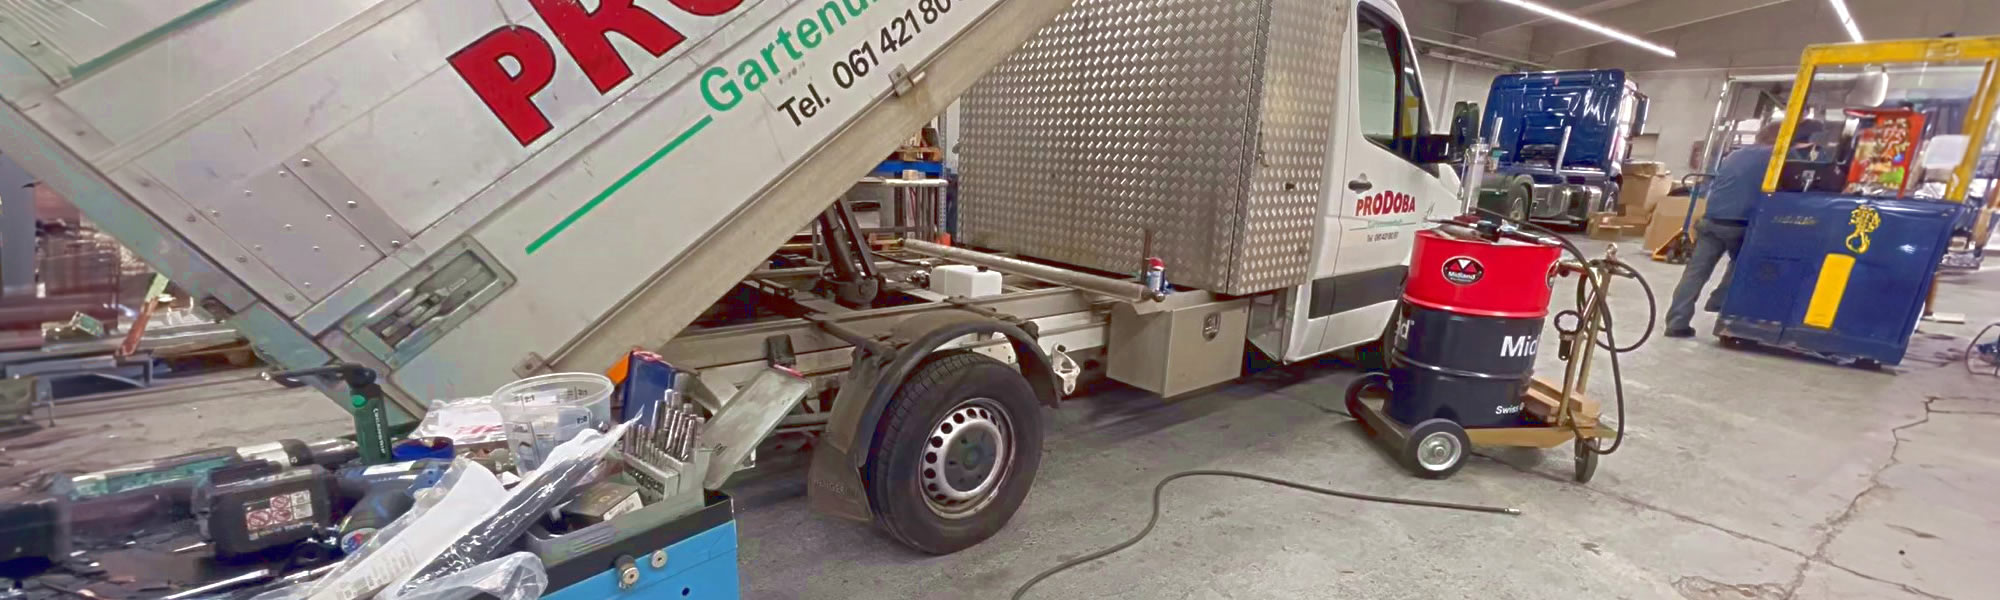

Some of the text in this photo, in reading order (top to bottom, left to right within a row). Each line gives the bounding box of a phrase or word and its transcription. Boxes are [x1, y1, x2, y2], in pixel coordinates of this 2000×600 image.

[445, 0, 748, 147] PR
[700, 0, 878, 111] Gartenu
[777, 83, 831, 127] Tel.
[832, 40, 879, 89] 061
[880, 9, 921, 53] 421
[1355, 190, 1416, 217] PRODOBA
[1448, 271, 1475, 280] Midland
